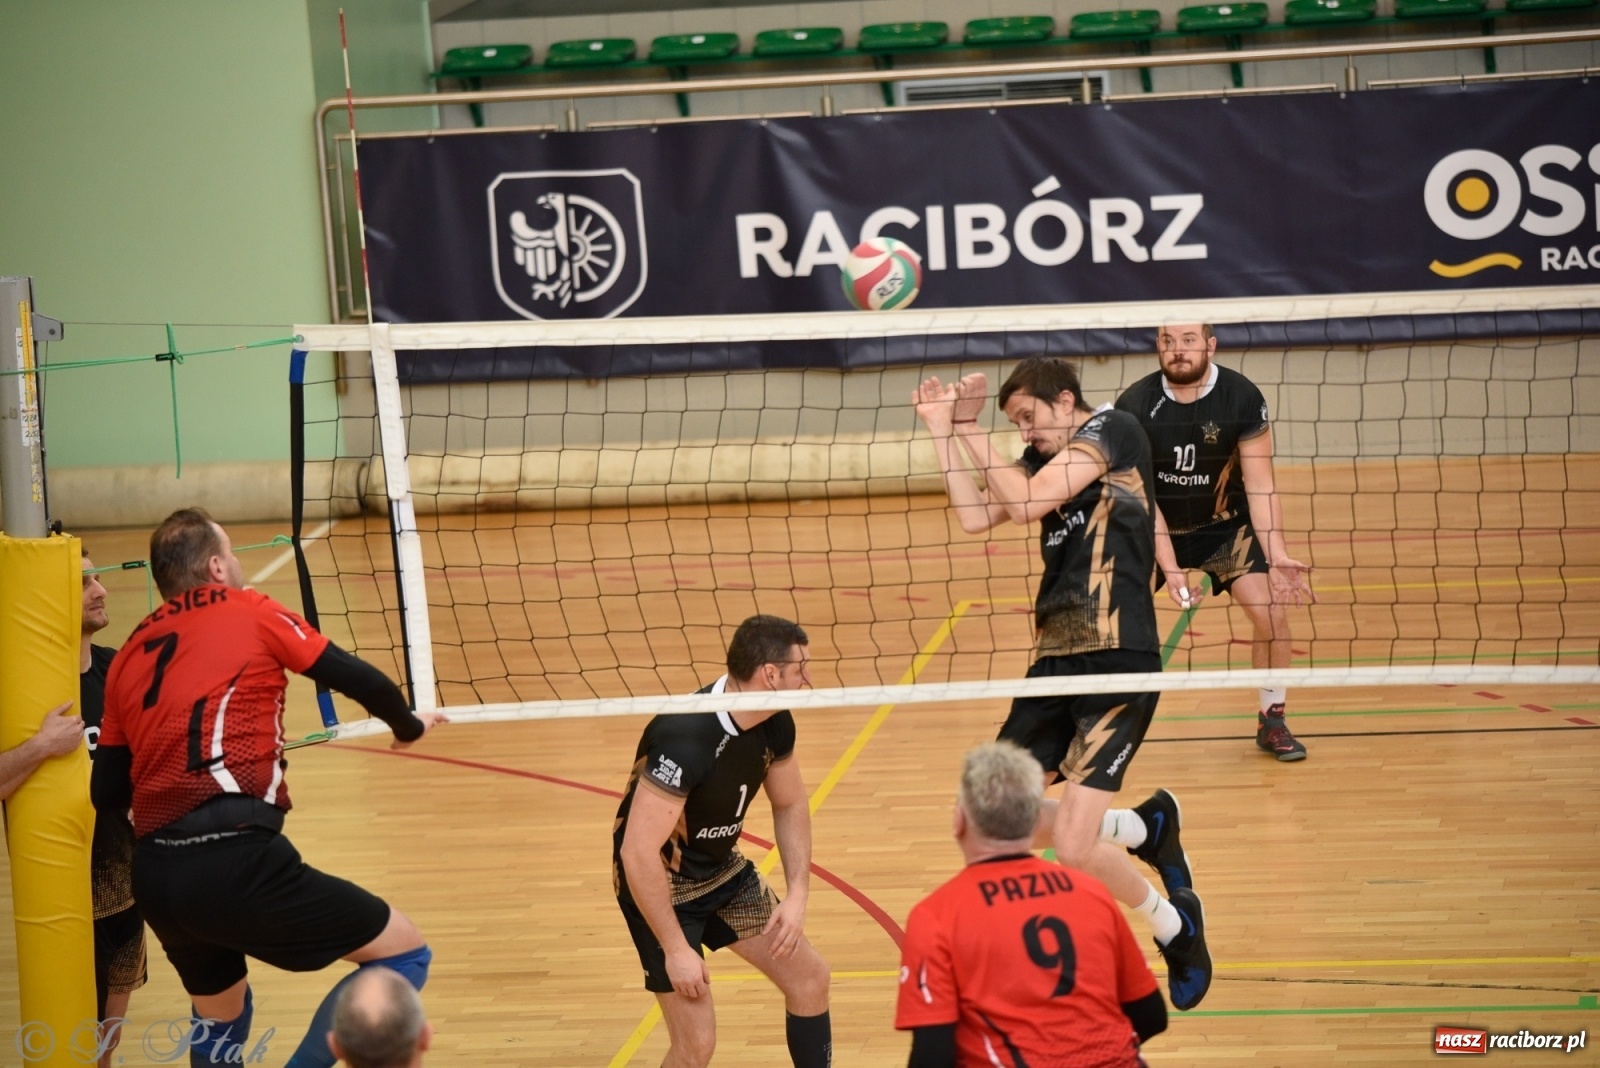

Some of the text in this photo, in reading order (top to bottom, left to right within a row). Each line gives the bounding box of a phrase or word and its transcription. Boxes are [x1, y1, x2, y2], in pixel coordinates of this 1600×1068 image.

[735, 175, 1208, 278] RACIBÓRZ
[1173, 443, 1196, 472] 10
[143, 631, 179, 711] 7
[735, 784, 748, 817] 1
[978, 871, 1074, 906] PAZIU
[1022, 914, 1077, 998] 9
